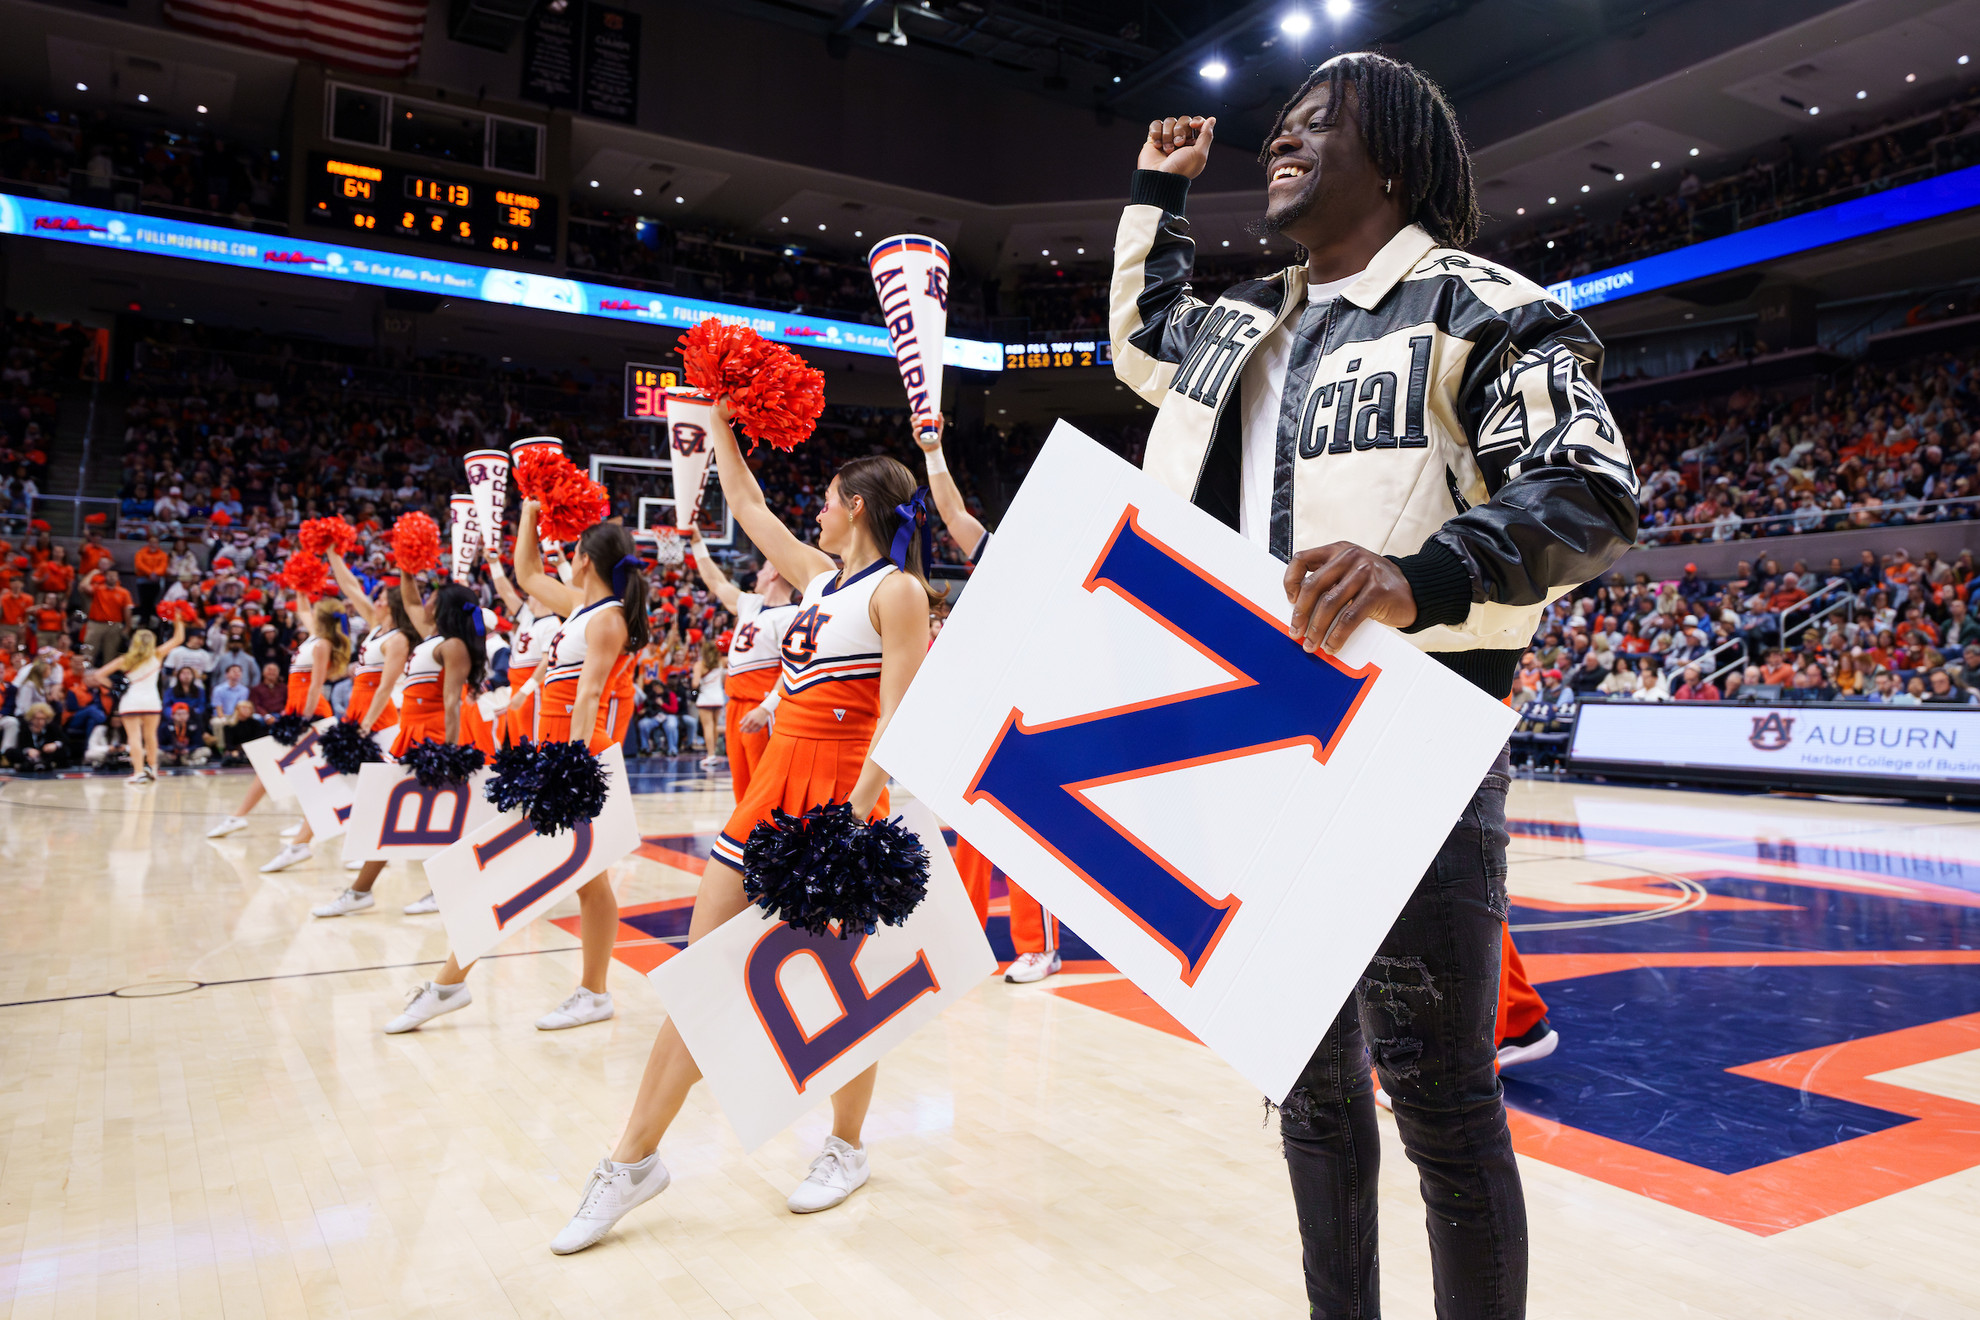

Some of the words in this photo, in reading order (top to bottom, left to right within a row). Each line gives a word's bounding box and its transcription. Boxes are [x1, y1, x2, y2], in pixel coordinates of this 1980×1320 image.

[343, 178, 371, 199] 64
[415, 179, 469, 207] 11:13
[508, 206, 532, 228] 36
[875, 266, 932, 417] AUBURN
[1080, 351, 1092, 367] 2
[635, 370, 677, 387] 11:13
[1300, 335, 1434, 460] cial
[492, 464, 508, 546] TIGERS
[962, 503, 1383, 988] N
[1804, 725, 1957, 750] AUBURN
[1800, 754, 1853, 767] Harbert
[1856, 754, 1914, 771] College
[1916, 758, 1933, 769] of
